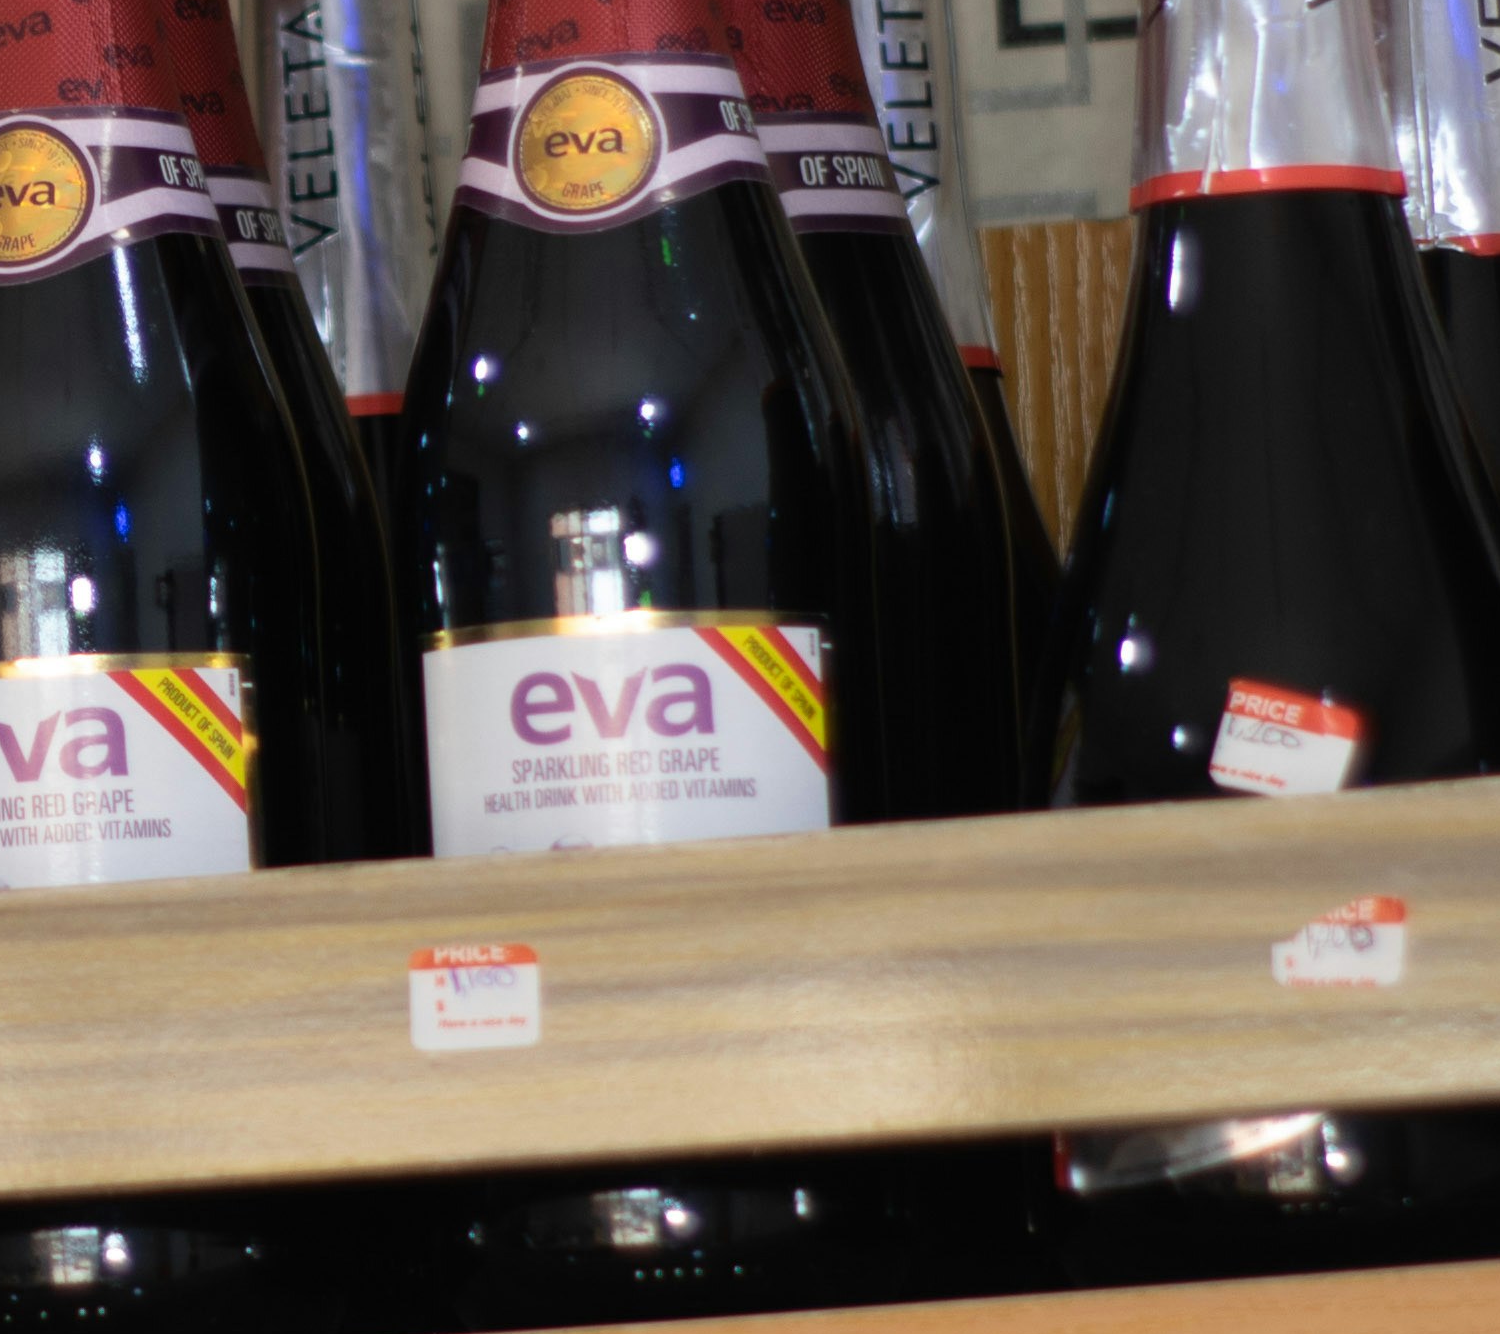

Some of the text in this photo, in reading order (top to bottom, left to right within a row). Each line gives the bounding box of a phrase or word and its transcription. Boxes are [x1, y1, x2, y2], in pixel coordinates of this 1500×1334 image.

[544, 127, 624, 158] eva
[800, 156, 885, 188] OF SPAIN
[156, 677, 235, 762] PRODUCT OF SPAIN
[510, 662, 716, 746] eva
[1229, 689, 1303, 725] PRICE
[511, 746, 722, 785] SPARKLING RED GRAPE
[32, 792, 66, 818] RED
[72, 789, 136, 816] GRAPE
[484, 777, 757, 814] HEALTH DRINK WITH ADDED VITAMINS
[0, 826, 38, 847] WITH
[42, 822, 93, 844] ADDED
[97, 818, 172, 841] VITAMINS
[433, 946, 506, 965] PRICE
